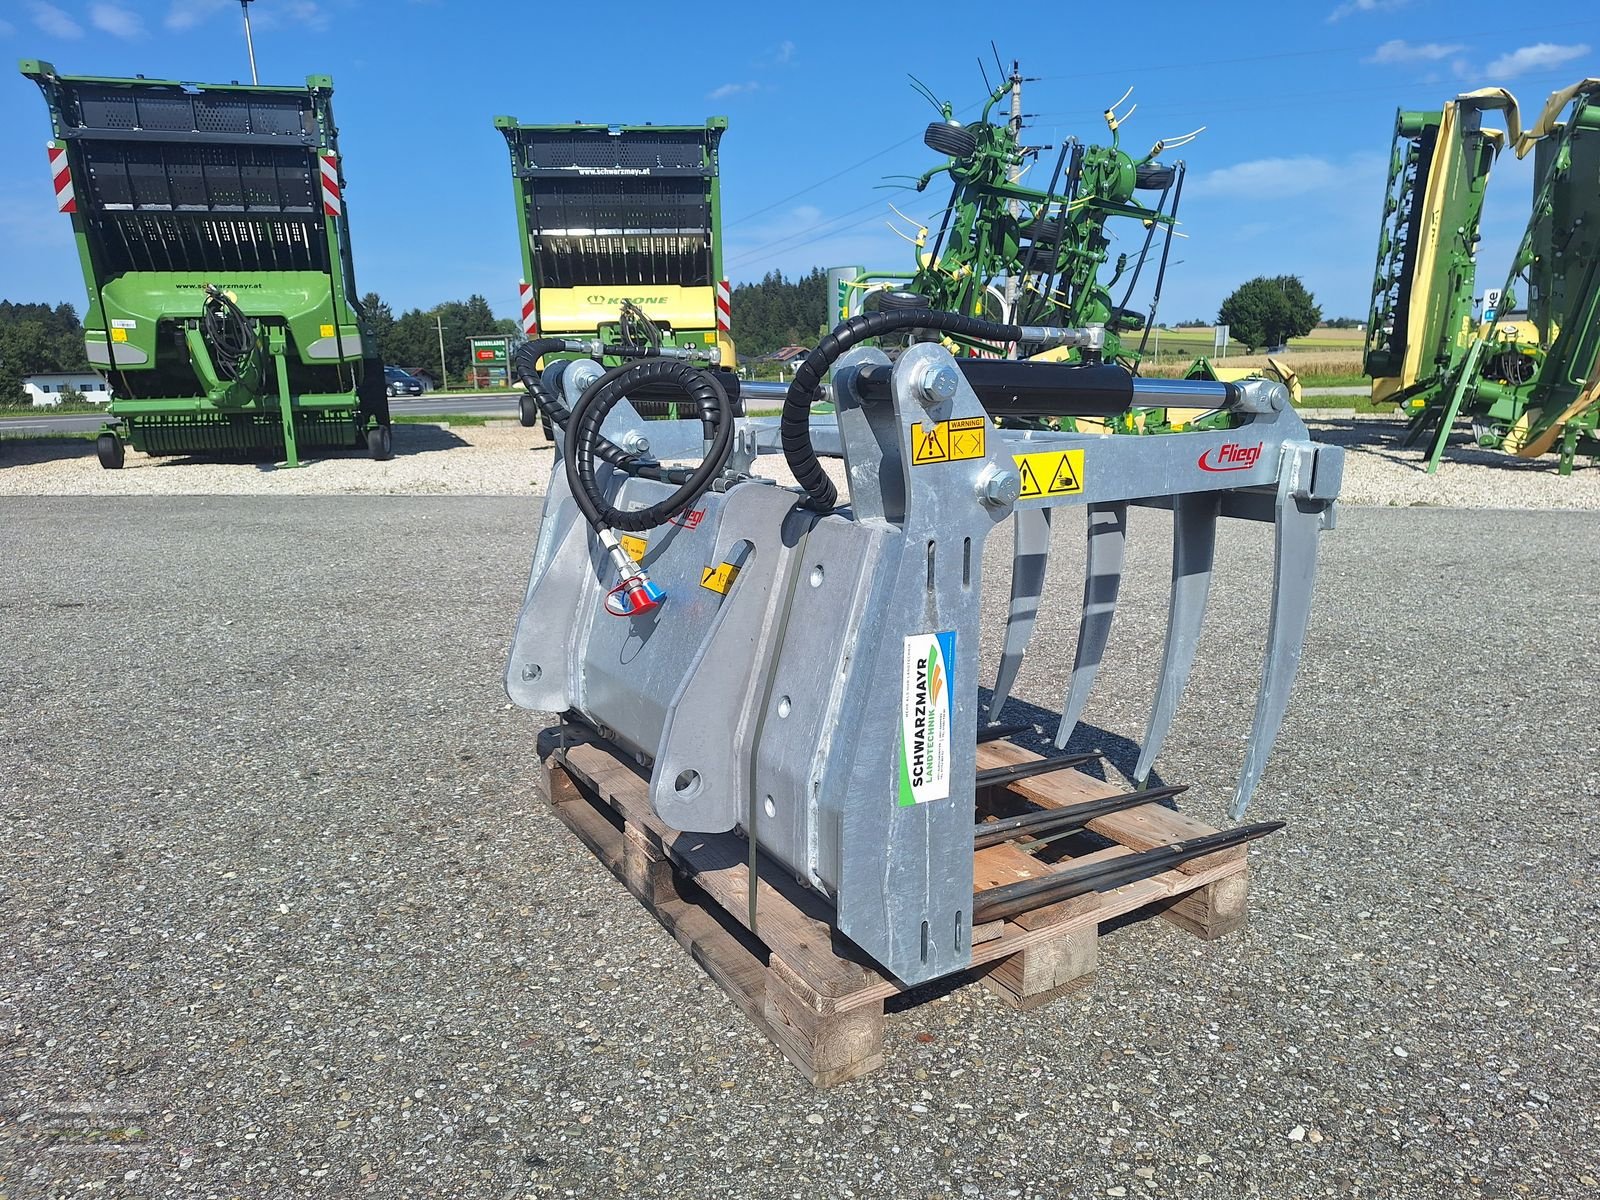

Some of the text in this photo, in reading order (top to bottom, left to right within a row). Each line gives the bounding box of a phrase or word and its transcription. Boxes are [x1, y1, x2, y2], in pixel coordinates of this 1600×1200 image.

[578, 167, 651, 176] www.schwarzmayr.at
[951, 419, 983, 428] WARNING!
[1217, 441, 1263, 466] Fliegl
[912, 658, 927, 788] SCHWARZMAYR
[926, 708, 935, 784] LANDTECHNIK
